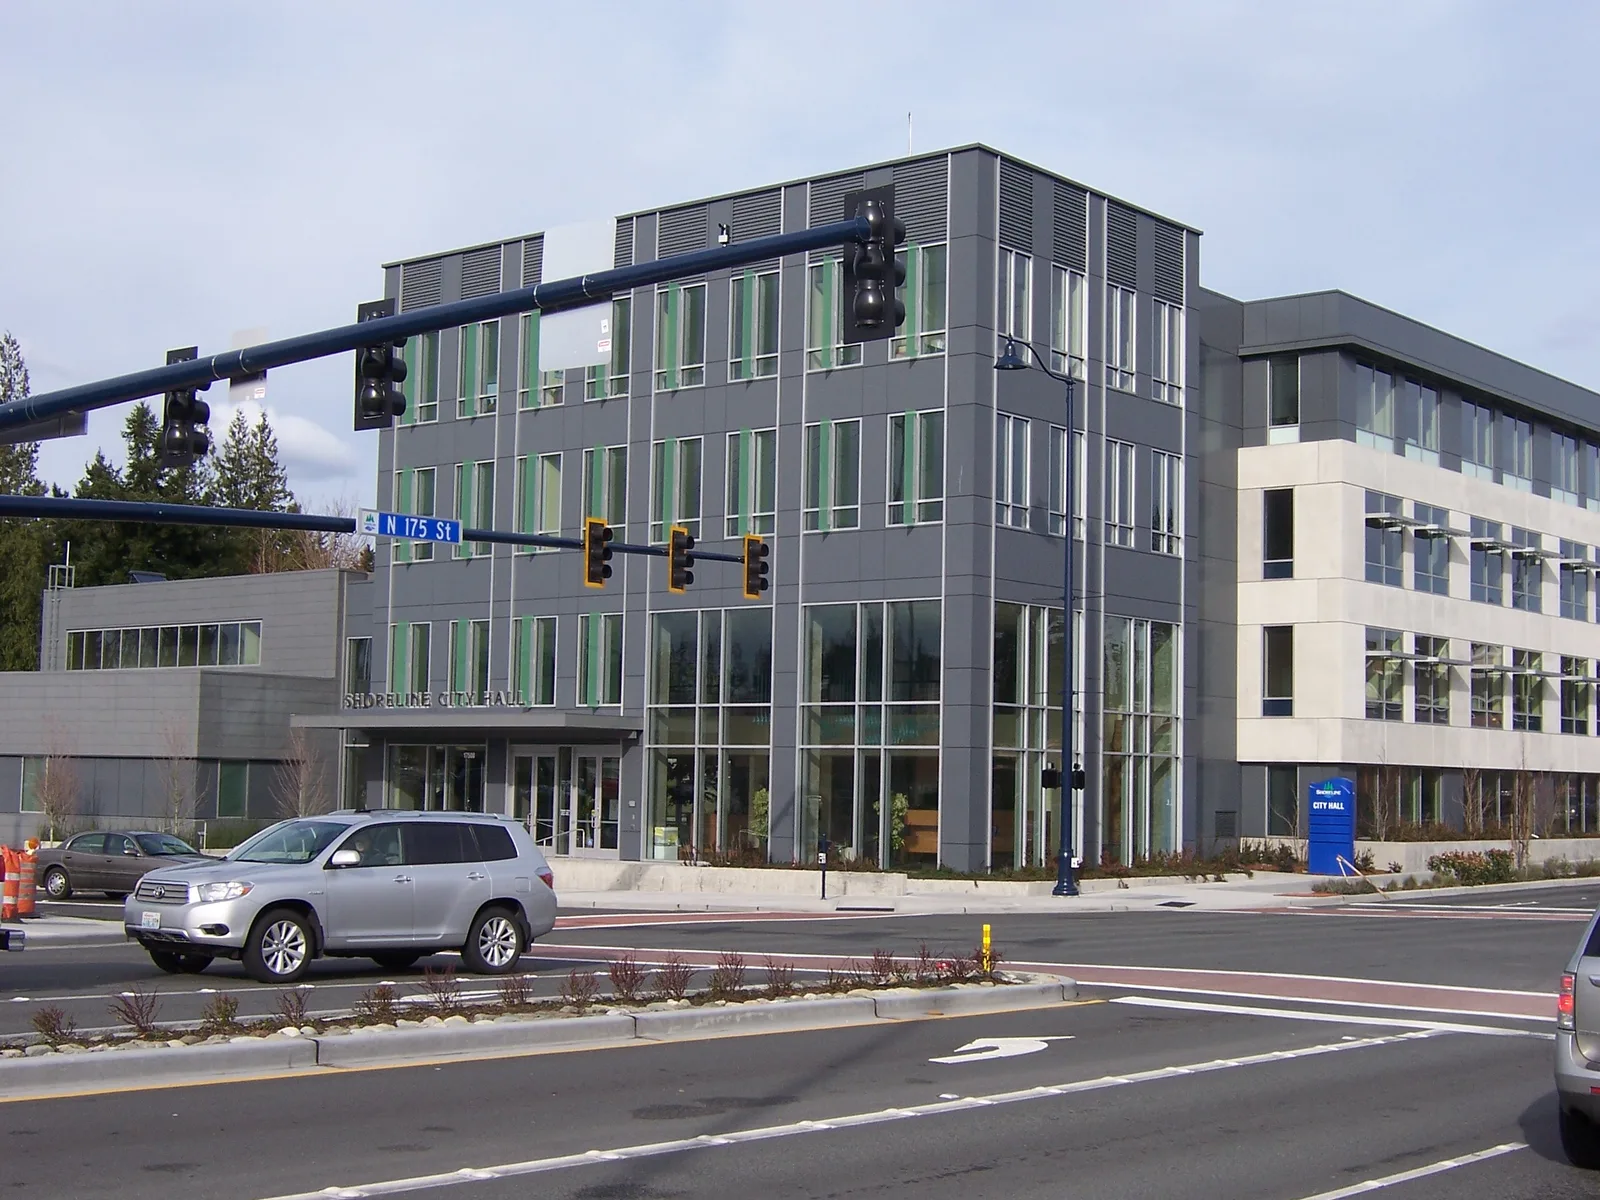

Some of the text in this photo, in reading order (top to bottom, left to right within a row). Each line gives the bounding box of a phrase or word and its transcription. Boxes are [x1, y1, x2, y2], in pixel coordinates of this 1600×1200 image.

[387, 515, 451, 541] N 175 St
[343, 690, 526, 709] SHORELINE CITY HALL
[1313, 802, 1344, 810] CITY HALL
